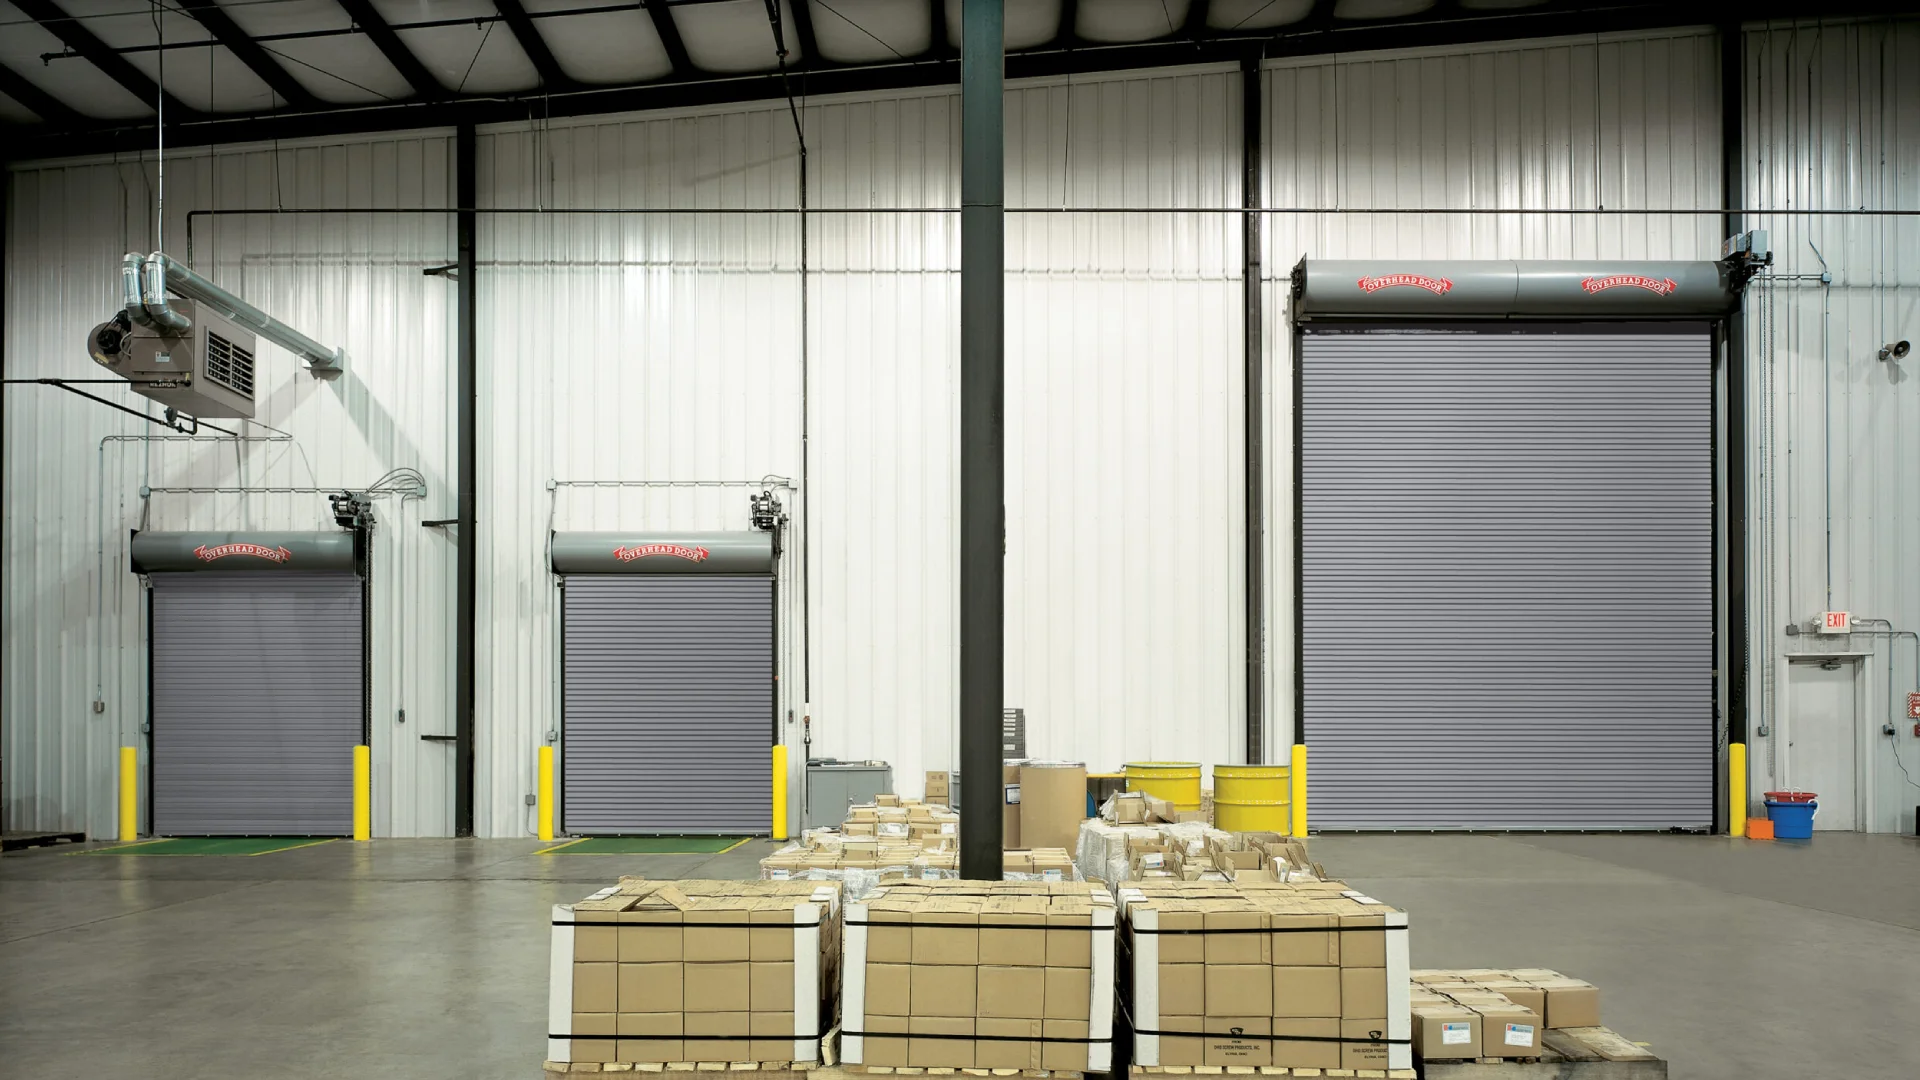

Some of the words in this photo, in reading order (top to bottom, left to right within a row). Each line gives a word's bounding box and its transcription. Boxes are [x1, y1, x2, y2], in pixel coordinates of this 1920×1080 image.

[1367, 276, 1417, 290] OVERHEAD
[1418, 277, 1442, 292] DOOR
[1591, 277, 1641, 291] OVERHEAD
[1642, 278, 1665, 293] DOOR
[204, 545, 254, 560] OVERHEAD
[255, 546, 281, 561] DOOR
[623, 545, 673, 560] OVERHEAD
[674, 547, 699, 561] DOOR
[1827, 613, 1846, 628] EXIT
